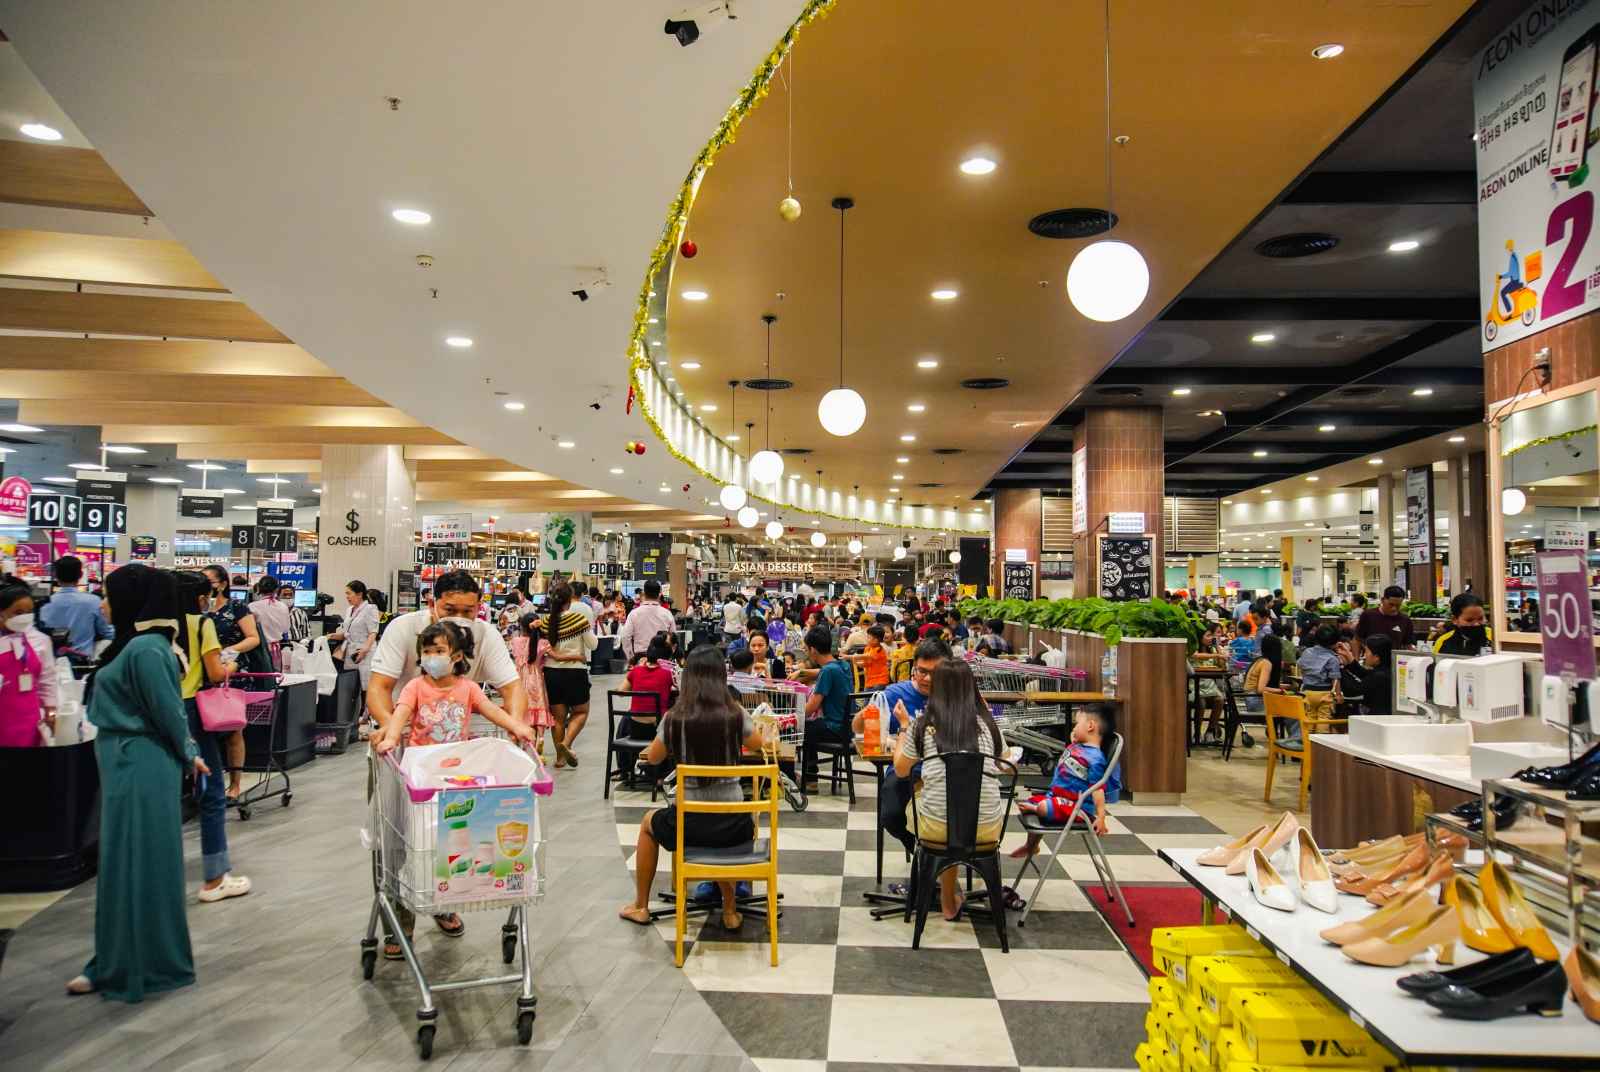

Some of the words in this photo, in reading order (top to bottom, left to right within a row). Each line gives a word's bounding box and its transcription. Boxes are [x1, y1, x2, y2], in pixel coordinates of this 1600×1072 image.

[1480, 175, 1506, 202] AEON
[1508, 148, 1547, 184] ONLINE
[1541, 190, 1594, 321] 2
[31, 501, 59, 521] 10
[67, 502, 77, 523] $
[88, 508, 103, 528] 9
[1361, 523, 1373, 531] GF
[238, 530, 248, 545] 8
[271, 533, 280, 548] 7
[327, 536, 377, 546] CASHIER
[427, 551, 434, 561] 5
[447, 559, 480, 569] ASHIMI
[499, 558, 506, 567] 4
[520, 559, 526, 568] 3
[732, 562, 765, 572] ASIAN
[767, 561, 814, 572] DESSERTS
[276, 565, 307, 575] PEPSI
[591, 564, 598, 573] 2
[1544, 592, 1580, 639] 50
